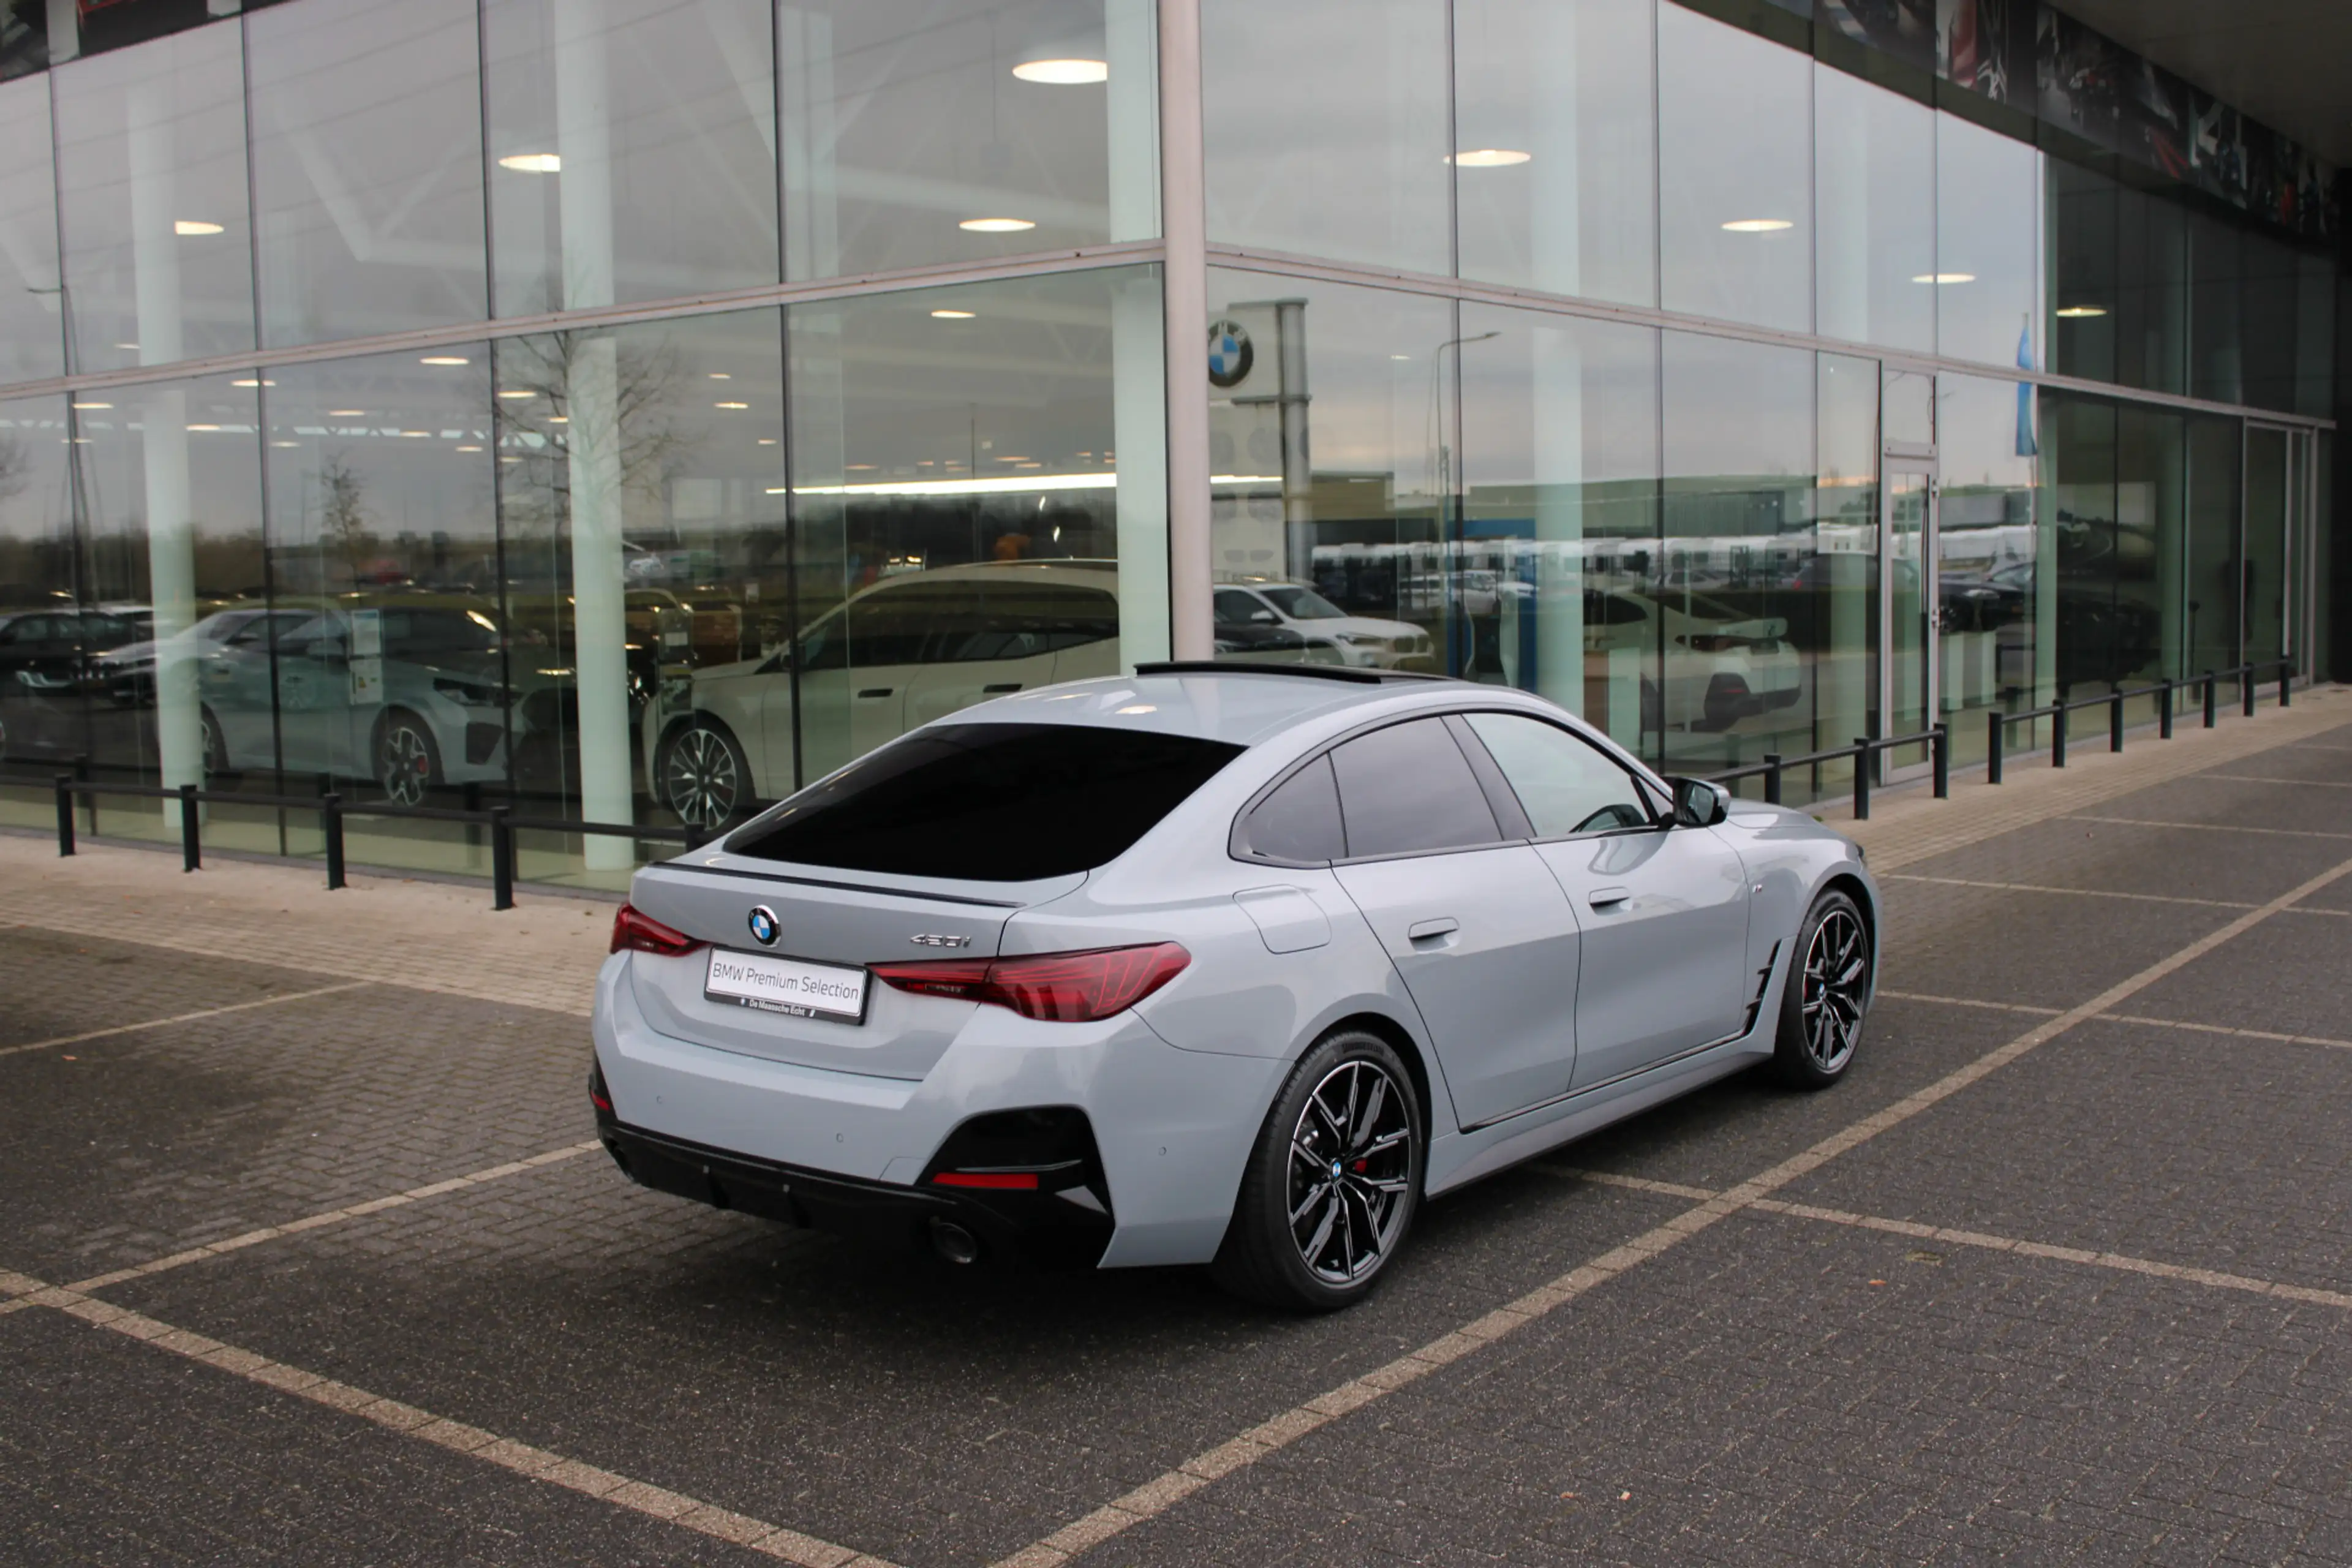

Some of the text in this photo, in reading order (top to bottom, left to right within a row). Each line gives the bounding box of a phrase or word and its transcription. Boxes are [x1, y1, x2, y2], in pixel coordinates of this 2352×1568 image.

[713, 963, 858, 1000] BMW Premium Selection
[749, 999, 758, 1008] De
[790, 1005, 805, 1016] Echt
